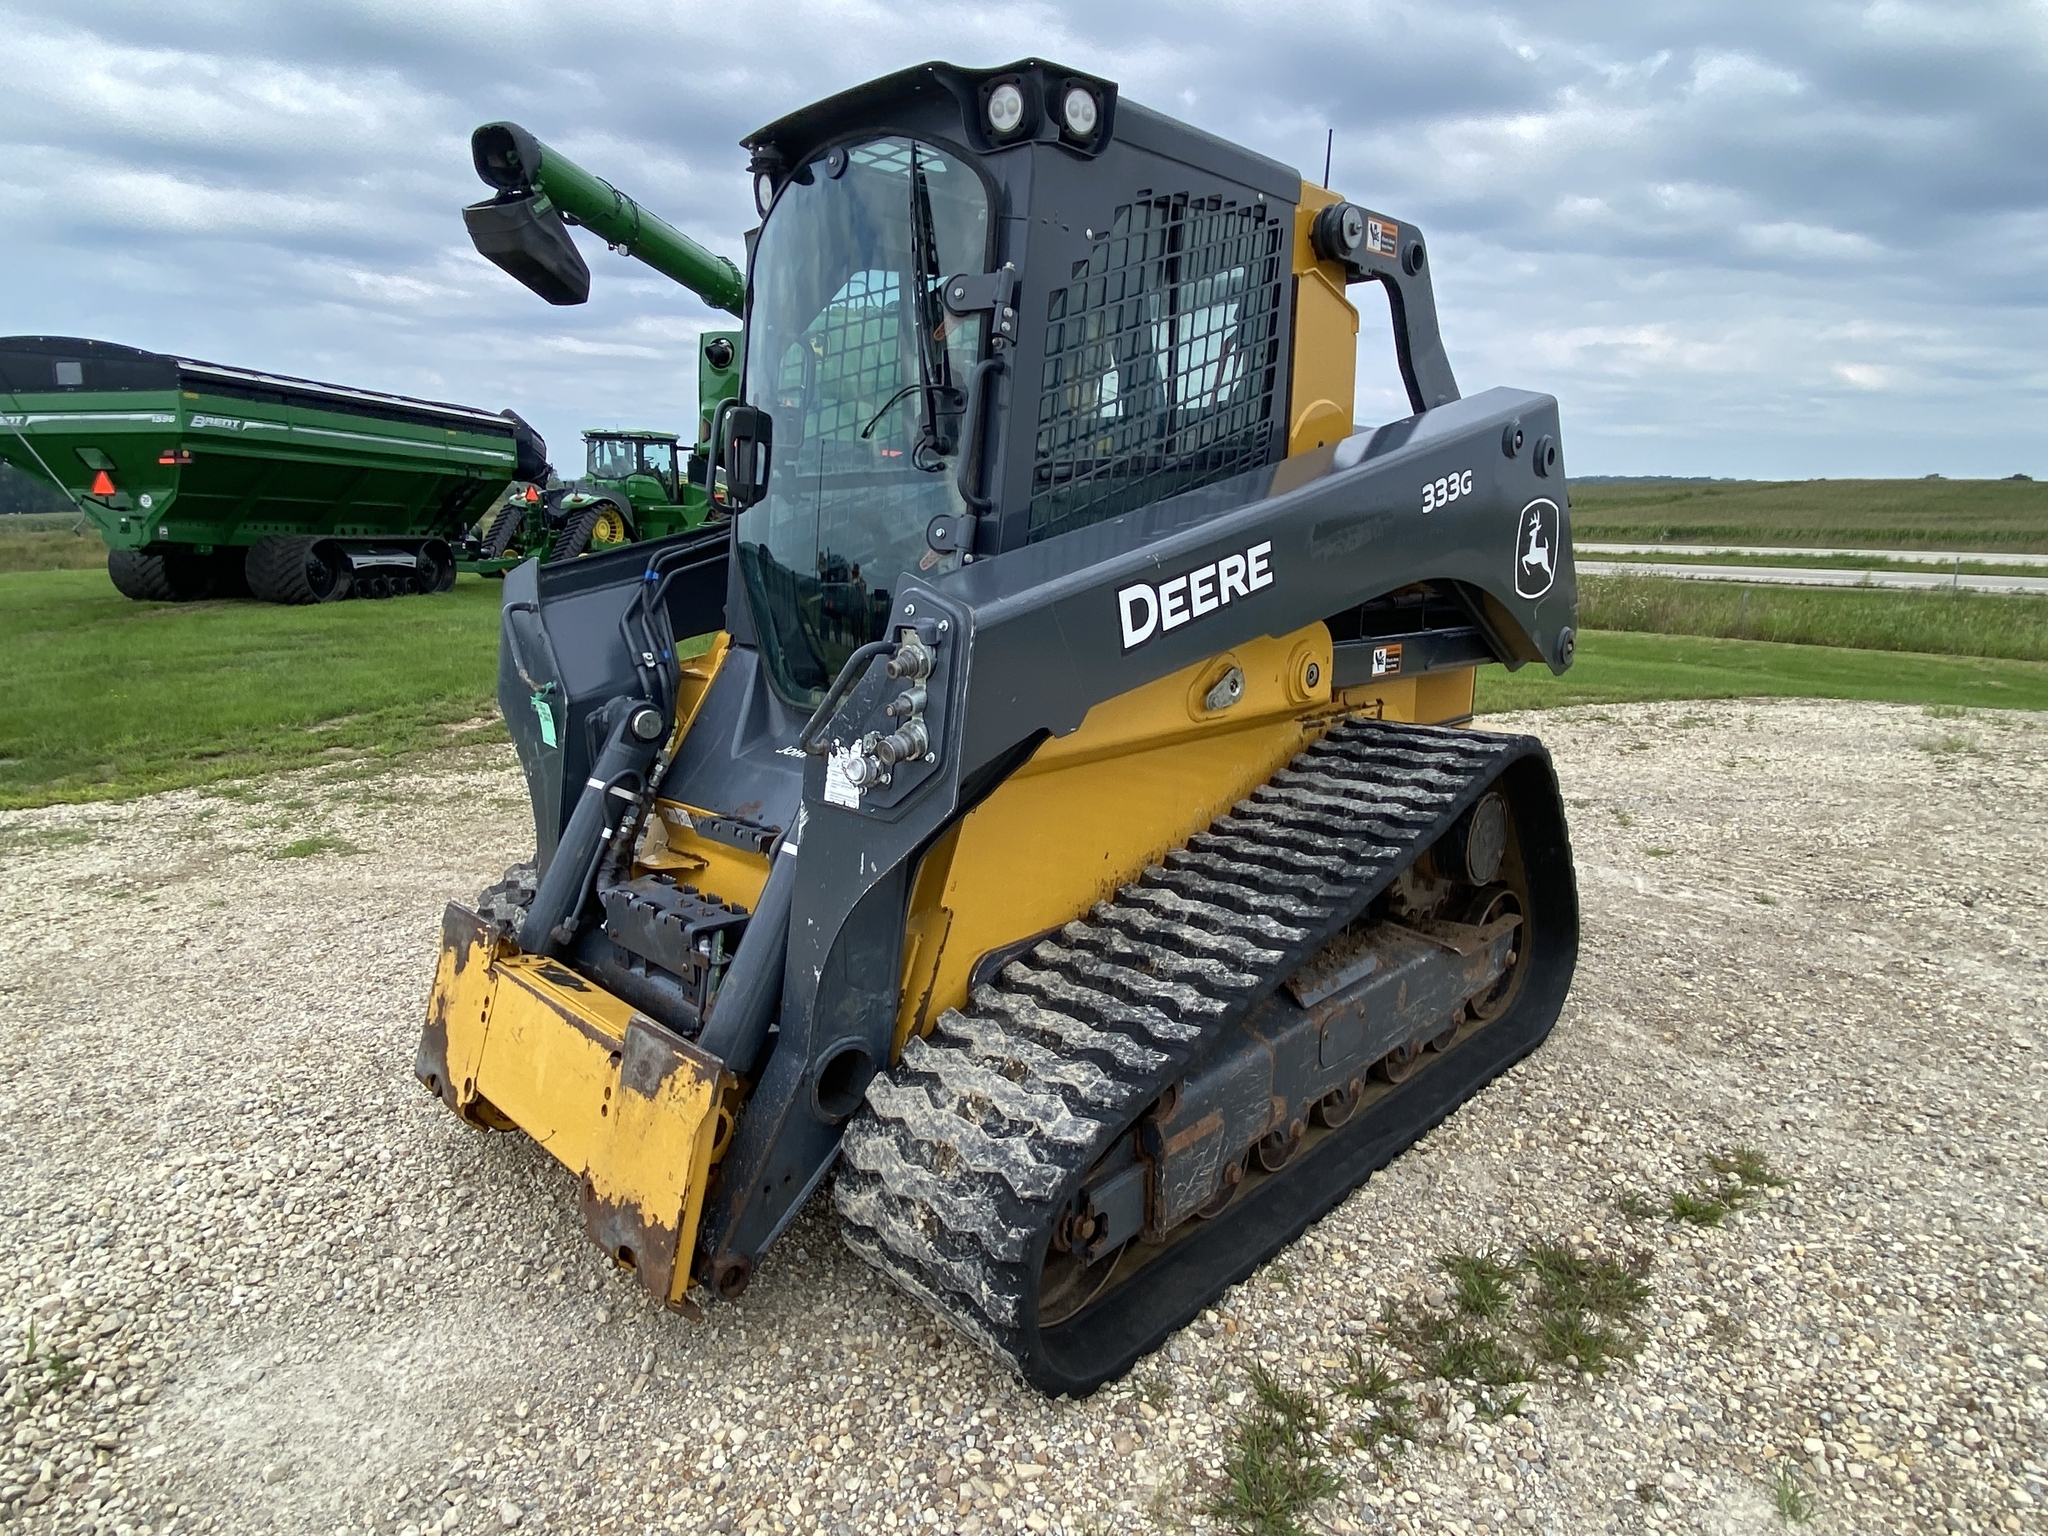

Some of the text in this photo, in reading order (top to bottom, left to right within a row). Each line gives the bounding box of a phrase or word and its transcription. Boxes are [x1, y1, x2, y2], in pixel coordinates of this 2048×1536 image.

[190, 415, 241, 429] BRENT
[1422, 469, 1472, 514] 333G
[1118, 540, 1274, 649] DEERE
